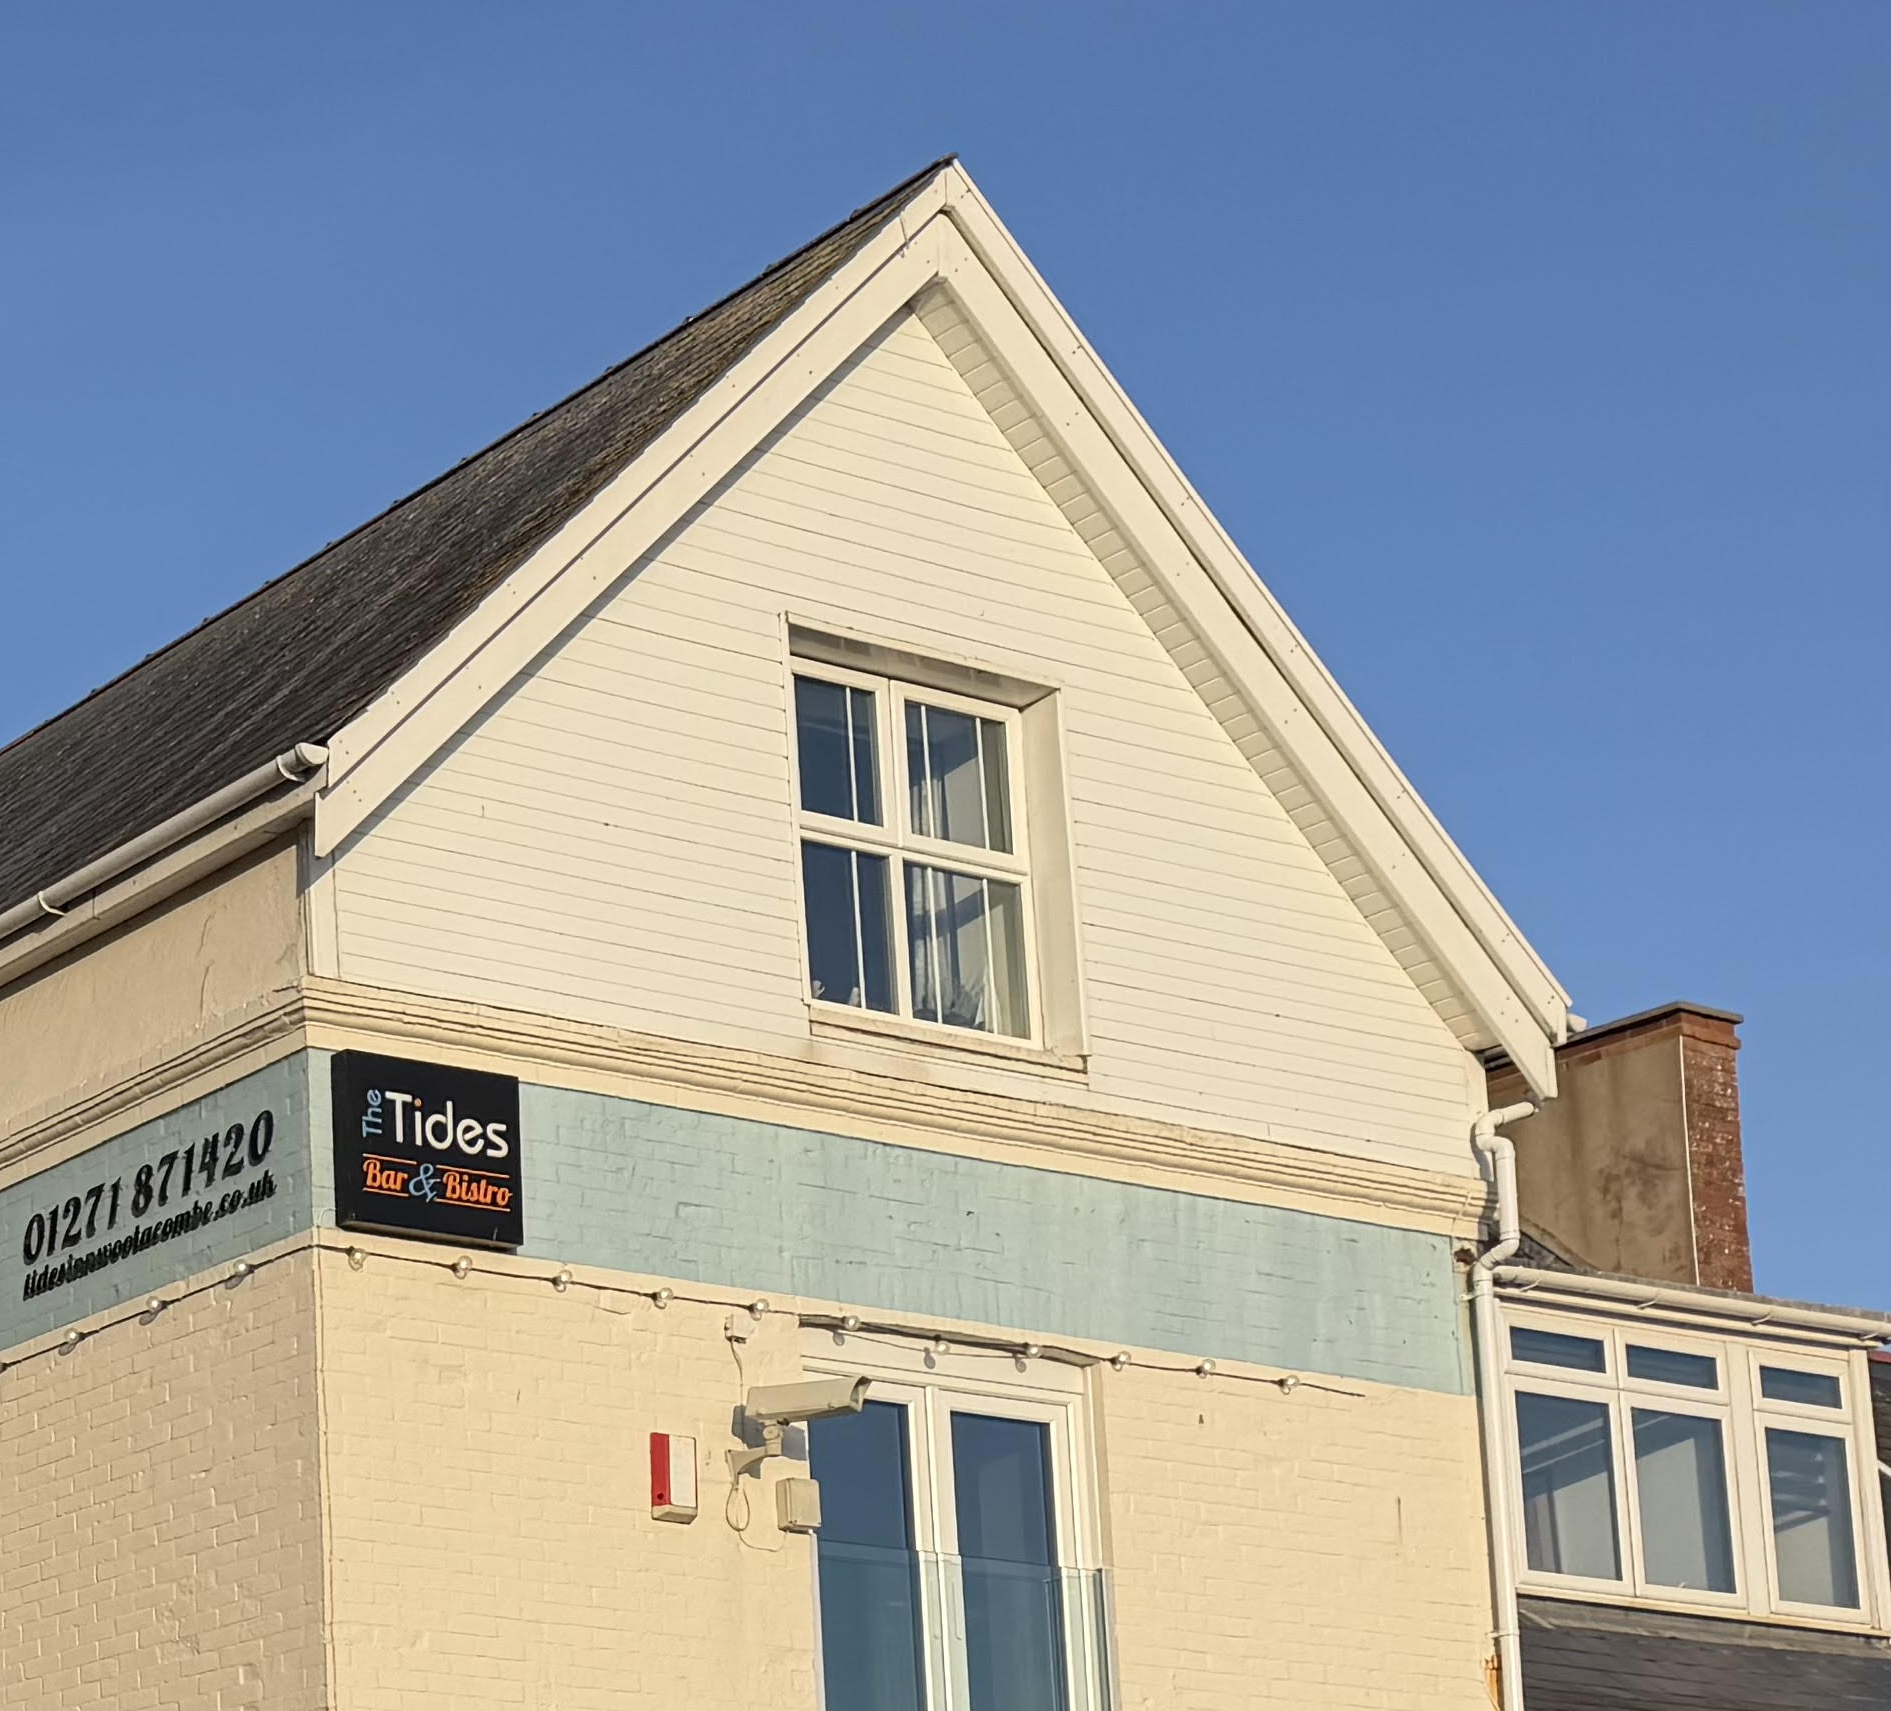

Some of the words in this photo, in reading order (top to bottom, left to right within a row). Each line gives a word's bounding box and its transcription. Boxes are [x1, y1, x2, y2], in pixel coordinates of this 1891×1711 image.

[362, 1089, 382, 1138] The
[384, 1090, 509, 1158] Tides
[23, 1175, 122, 1266] 01271
[131, 1109, 274, 1218] 871420
[362, 1159, 408, 1191] Bar
[408, 1163, 441, 1203] &
[442, 1171, 513, 1206] Bistro
